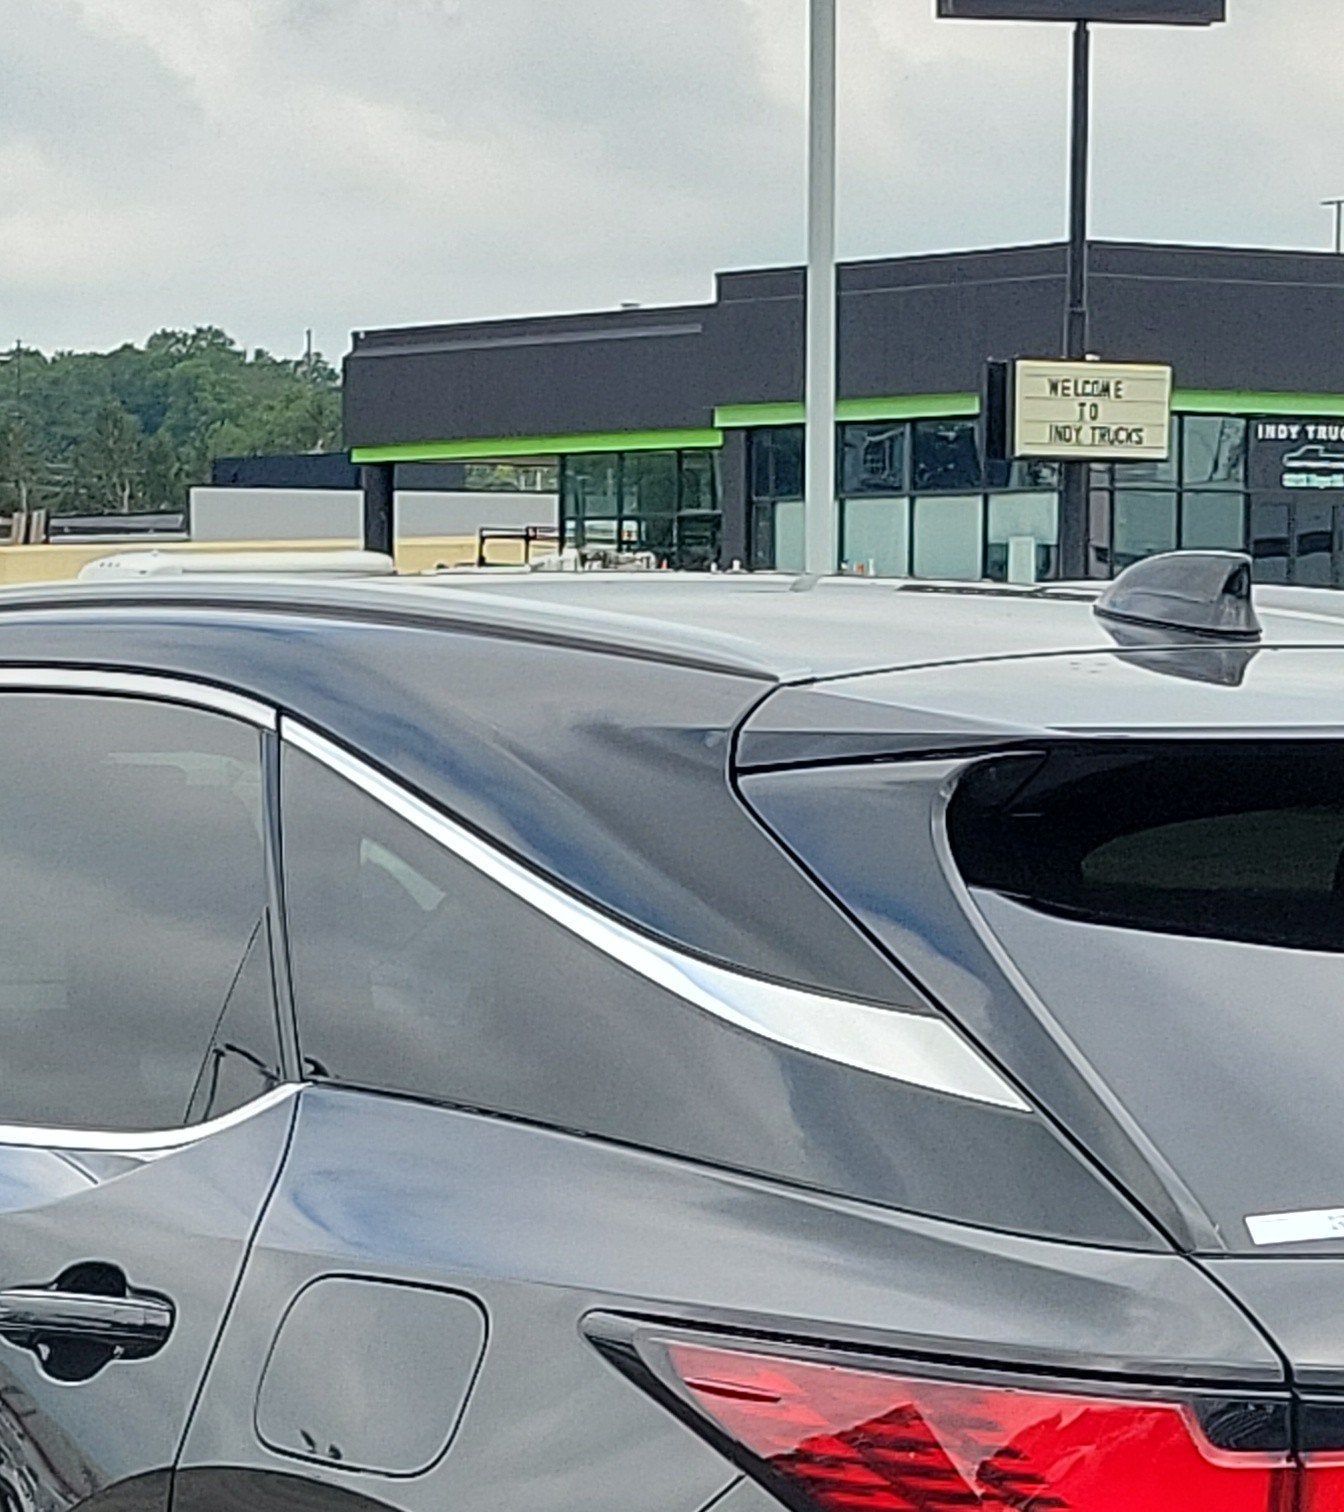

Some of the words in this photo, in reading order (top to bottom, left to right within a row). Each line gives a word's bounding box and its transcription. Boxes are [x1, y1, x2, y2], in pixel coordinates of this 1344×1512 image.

[1048, 378, 1123, 399] WELCOME
[1078, 402, 1099, 421] TO
[1049, 424, 1083, 444] INDY
[1090, 425, 1144, 446] TRUCKS
[1257, 423, 1300, 440] INDY
